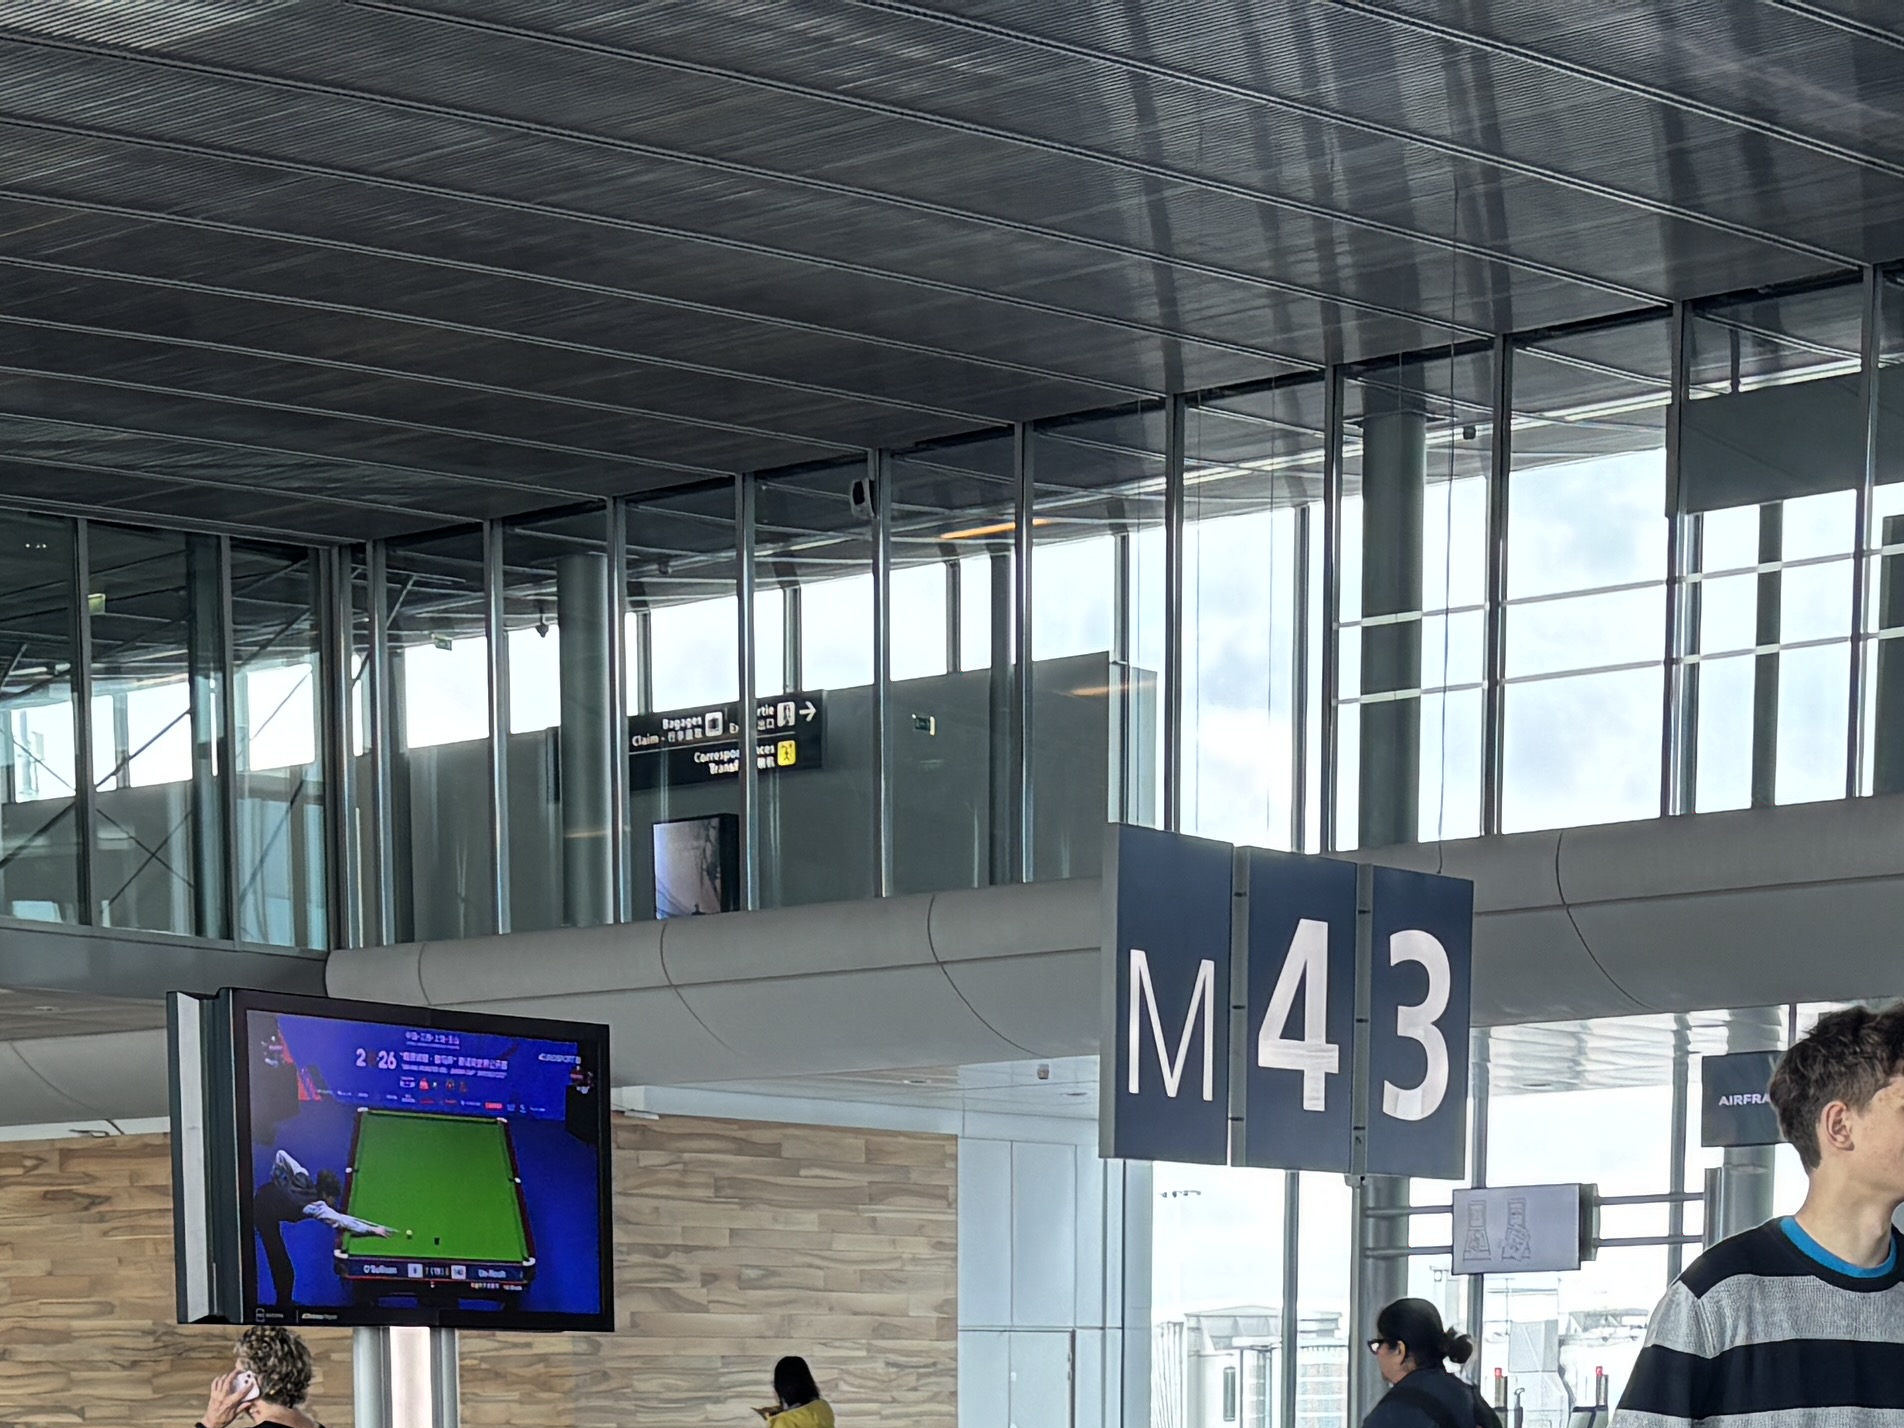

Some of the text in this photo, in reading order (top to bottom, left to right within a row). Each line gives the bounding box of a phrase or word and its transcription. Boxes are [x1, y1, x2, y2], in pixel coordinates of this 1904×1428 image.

[757, 704, 775, 717] rtie
[662, 716, 702, 730] Bagages
[632, 733, 660, 746] Claim
